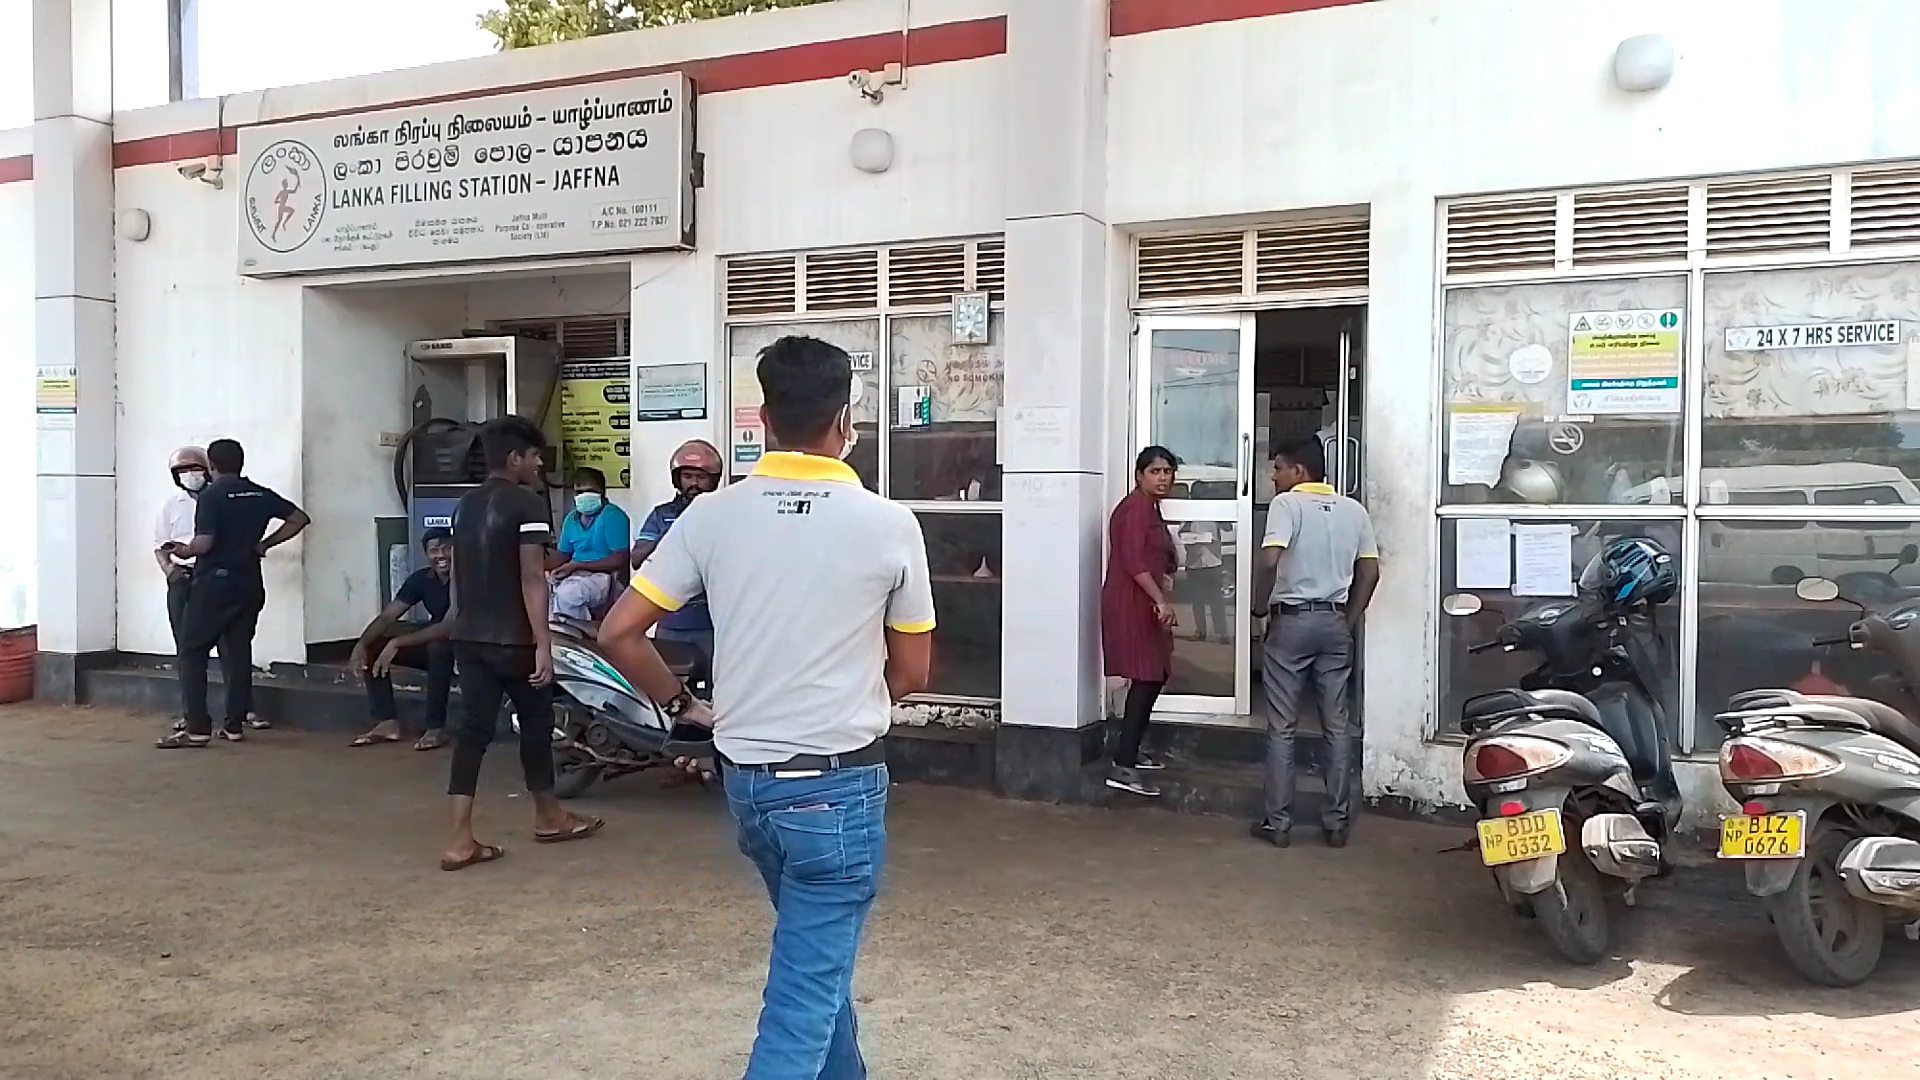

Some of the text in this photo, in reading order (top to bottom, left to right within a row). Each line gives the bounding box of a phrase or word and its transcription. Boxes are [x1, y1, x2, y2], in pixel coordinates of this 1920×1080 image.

[333, 124, 390, 149] லங்கா
[394, 117, 441, 146] நிரப்பு
[447, 105, 532, 140] நிலையம்
[552, 88, 673, 130] யாழ்ப்பாணம்
[333, 158, 381, 181] ලංකා
[553, 128, 648, 157] යාපනය
[332, 186, 385, 210] LANKA
[391, 180, 452, 204] FILLING
[459, 172, 532, 199] STATION
[552, 165, 620, 191] JAFFNA
[302, 193, 322, 233] LANKA
[1756, 323, 1895, 347] 24 X 7 HRS SERVICE
[1507, 814, 1547, 837] BDD
[1484, 834, 1552, 857] NP 0332
[1725, 830, 1788, 855] NP 0676
